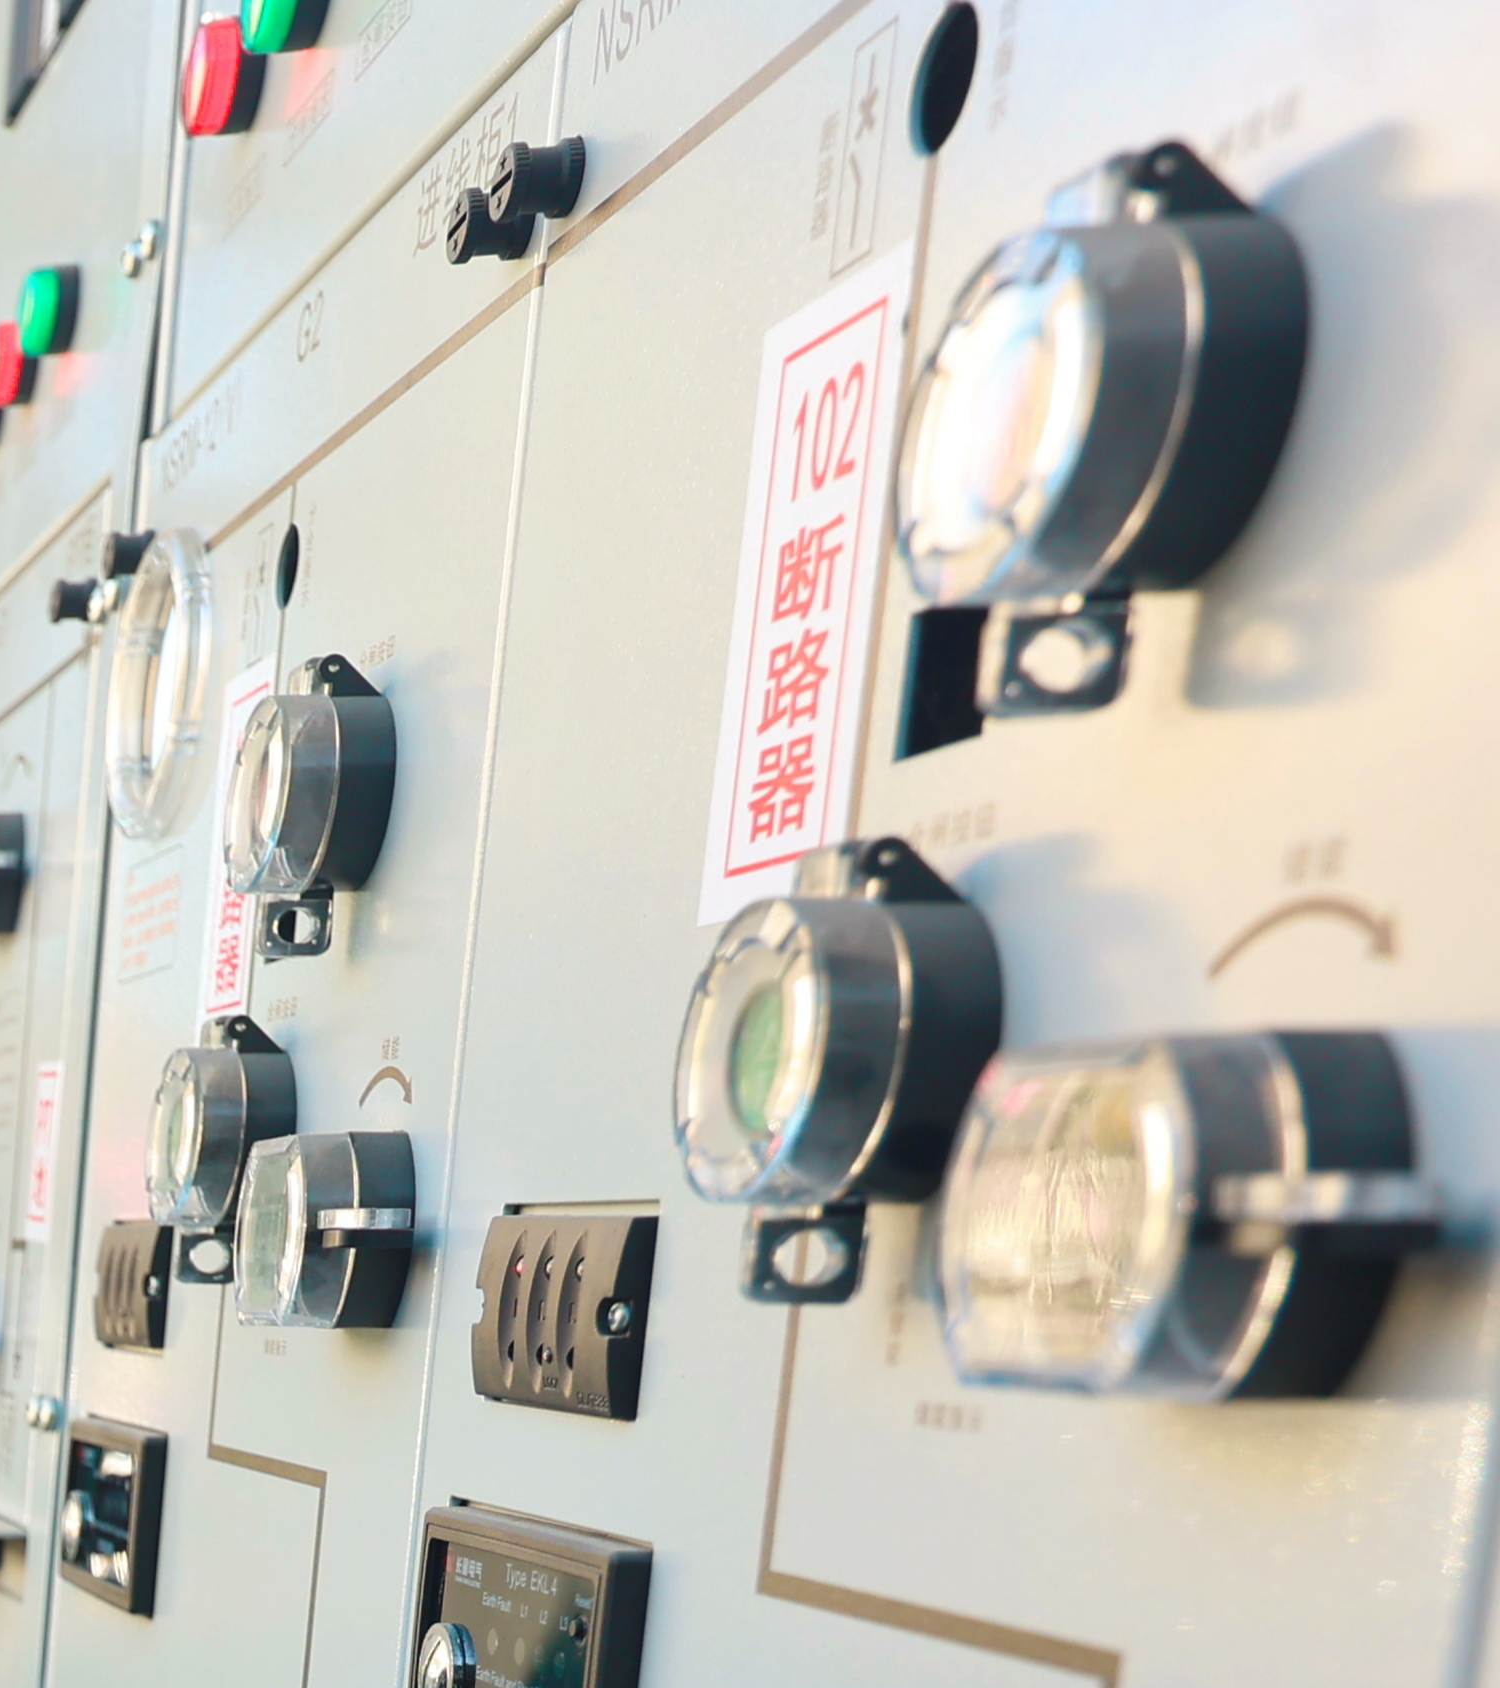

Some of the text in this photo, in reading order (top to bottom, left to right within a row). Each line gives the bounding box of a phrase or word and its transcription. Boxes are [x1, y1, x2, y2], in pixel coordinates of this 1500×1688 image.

[297, 289, 323, 363] G2
[792, 362, 865, 502] 102
[748, 512, 845, 843] 断路器
[482, 1591, 568, 1631] Earth Fault L1 L2 L3
[505, 1562, 527, 1590] Type
